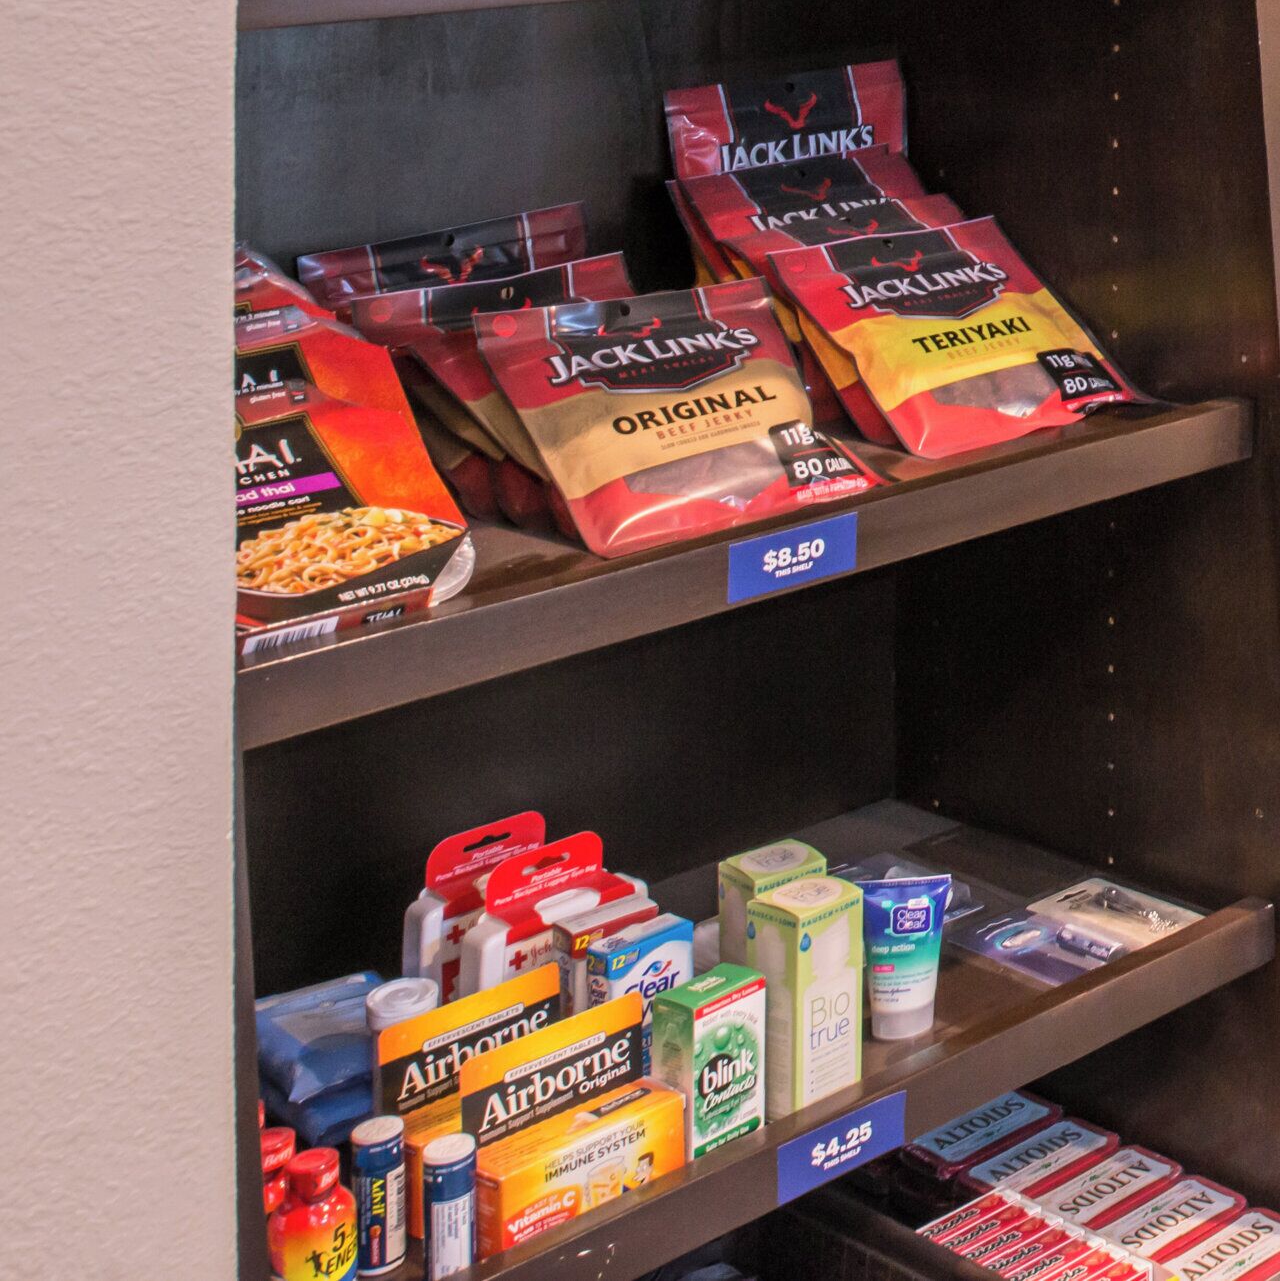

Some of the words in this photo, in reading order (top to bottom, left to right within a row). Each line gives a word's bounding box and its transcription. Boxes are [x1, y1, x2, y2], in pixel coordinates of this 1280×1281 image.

[792, 125, 873, 159] LINK'S
[843, 275, 926, 308] JACK
[916, 263, 1008, 290] LINK'S
[912, 317, 1032, 353] TERIYAKI
[550, 344, 653, 383] JACK
[644, 328, 758, 359] LINK'S
[1064, 377, 1087, 393] 80
[613, 386, 777, 435] ORIGINAL
[656, 423, 697, 439] BEEF
[705, 410, 753, 428] JERKY
[780, 422, 815, 446] 11g
[793, 458, 823, 478] 80
[262, 482, 295, 497] thai
[247, 501, 285, 514] noodle
[763, 539, 825, 573] $8.50
[775, 569, 791, 578] THIS
[792, 562, 813, 574] SHELF
[472, 845, 504, 861] Portable
[531, 867, 562, 882] Portable
[801, 909, 833, 927] BAUSCH
[840, 899, 860, 912] LOMB
[574, 935, 590, 950] 12
[872, 944, 890, 956] deep
[892, 943, 915, 952] action
[612, 954, 626, 971] 12
[488, 1006, 520, 1023] TABLETS
[810, 1018, 850, 1050] true
[509, 1050, 568, 1079] EFFERVESCENT
[569, 1035, 602, 1053] TABLETS
[702, 1049, 754, 1094] blink
[479, 1034, 631, 1133] Airborne
[579, 1061, 631, 1094] Original
[704, 1074, 755, 1113] Contacts
[933, 1098, 1026, 1150] ALTOIDS
[545, 1153, 574, 1170] HELPS
[576, 1133, 617, 1156] SUPPORT
[620, 1120, 644, 1137] YOUR
[545, 1153, 595, 1183] IMMUNE
[598, 1129, 647, 1156] SYSTEM
[811, 1121, 872, 1167] $4.25
[823, 1157, 840, 1171] THIS
[840, 1146, 861, 1164] SHELF
[990, 1127, 1082, 1181] ALTOIDS
[1060, 1159, 1151, 1214] ALTOIDS
[508, 1202, 561, 1234] Vitamin
[562, 1190, 576, 1206] C
[1121, 1191, 1216, 1248] ALTOIDS
[1180, 1220, 1274, 1281] ALTOIDS
